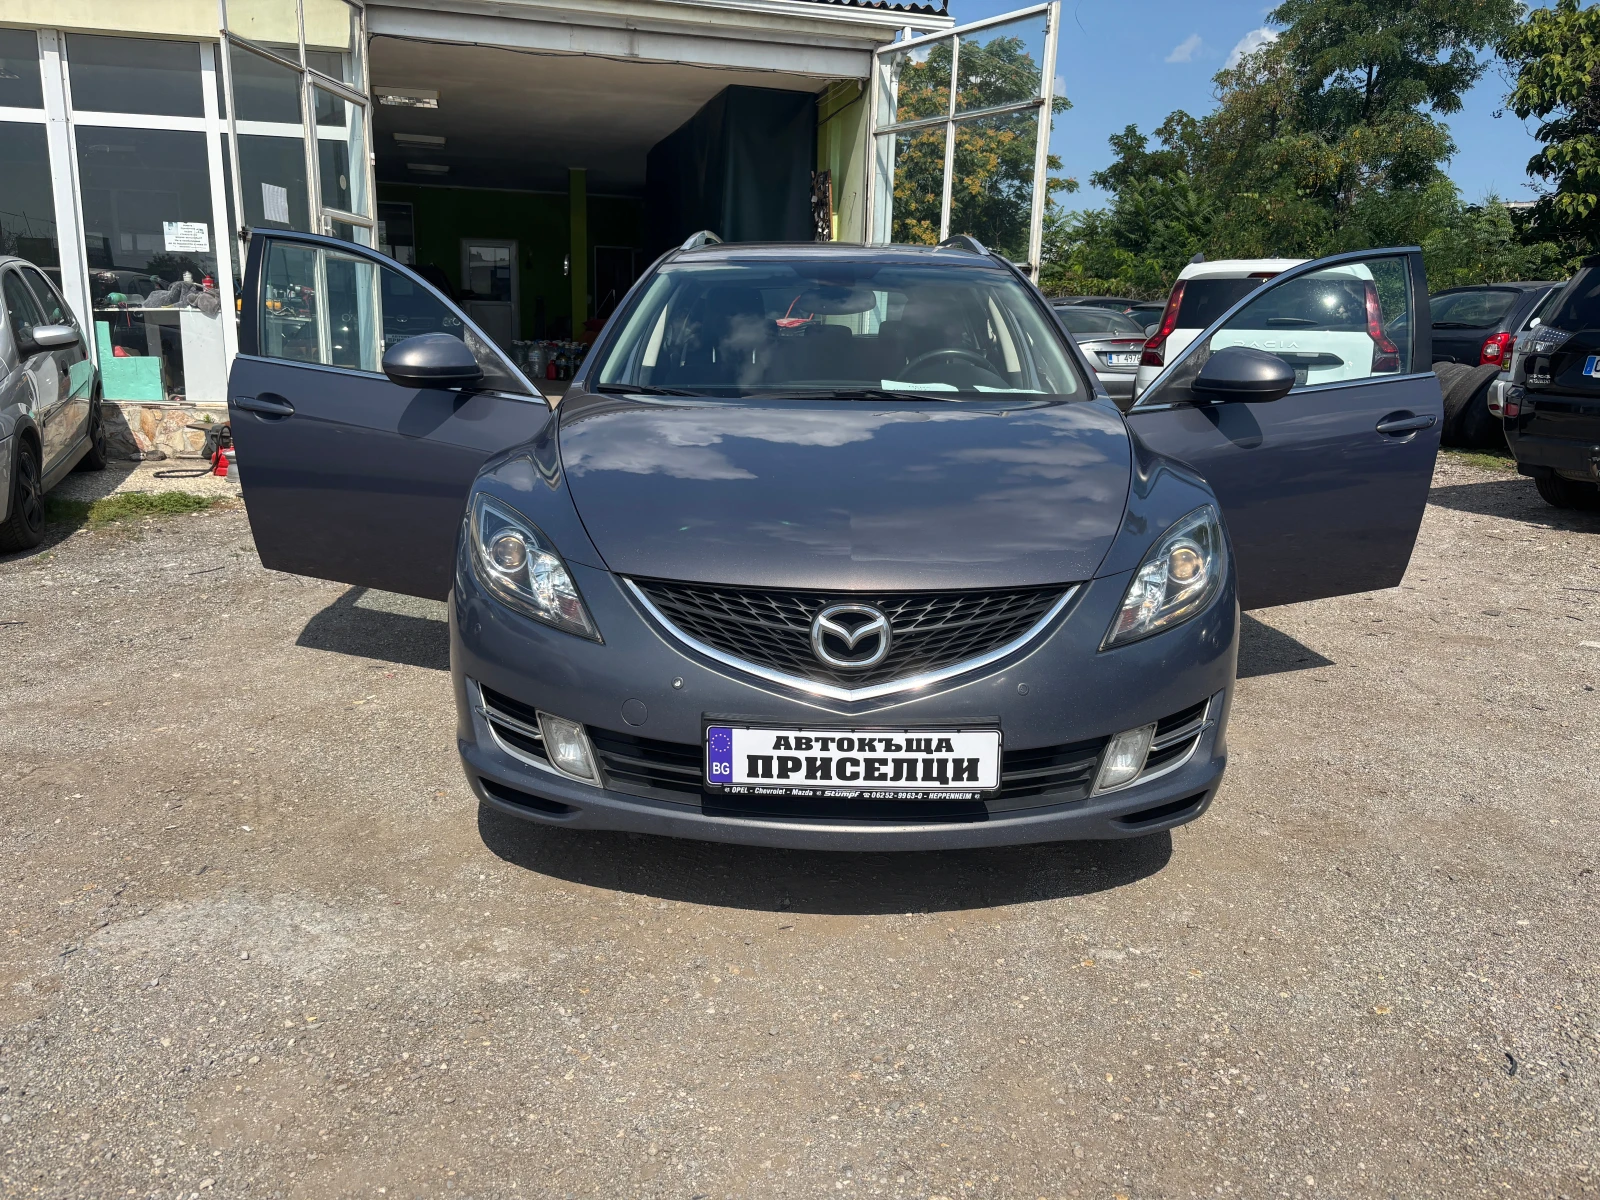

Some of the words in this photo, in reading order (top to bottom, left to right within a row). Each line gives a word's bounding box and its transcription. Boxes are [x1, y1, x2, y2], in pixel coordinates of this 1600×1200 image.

[1233, 340, 1300, 349] DACIA
[772, 735, 955, 755] АВТОКЪЩА
[712, 762, 731, 776] BG
[746, 754, 981, 786] ПРИСЕЛЦИ
[731, 786, 749, 794] OPEL
[754, 787, 786, 796] Chevrolet
[791, 788, 814, 797] Mazda
[928, 792, 973, 801] HEPPENHEIM
